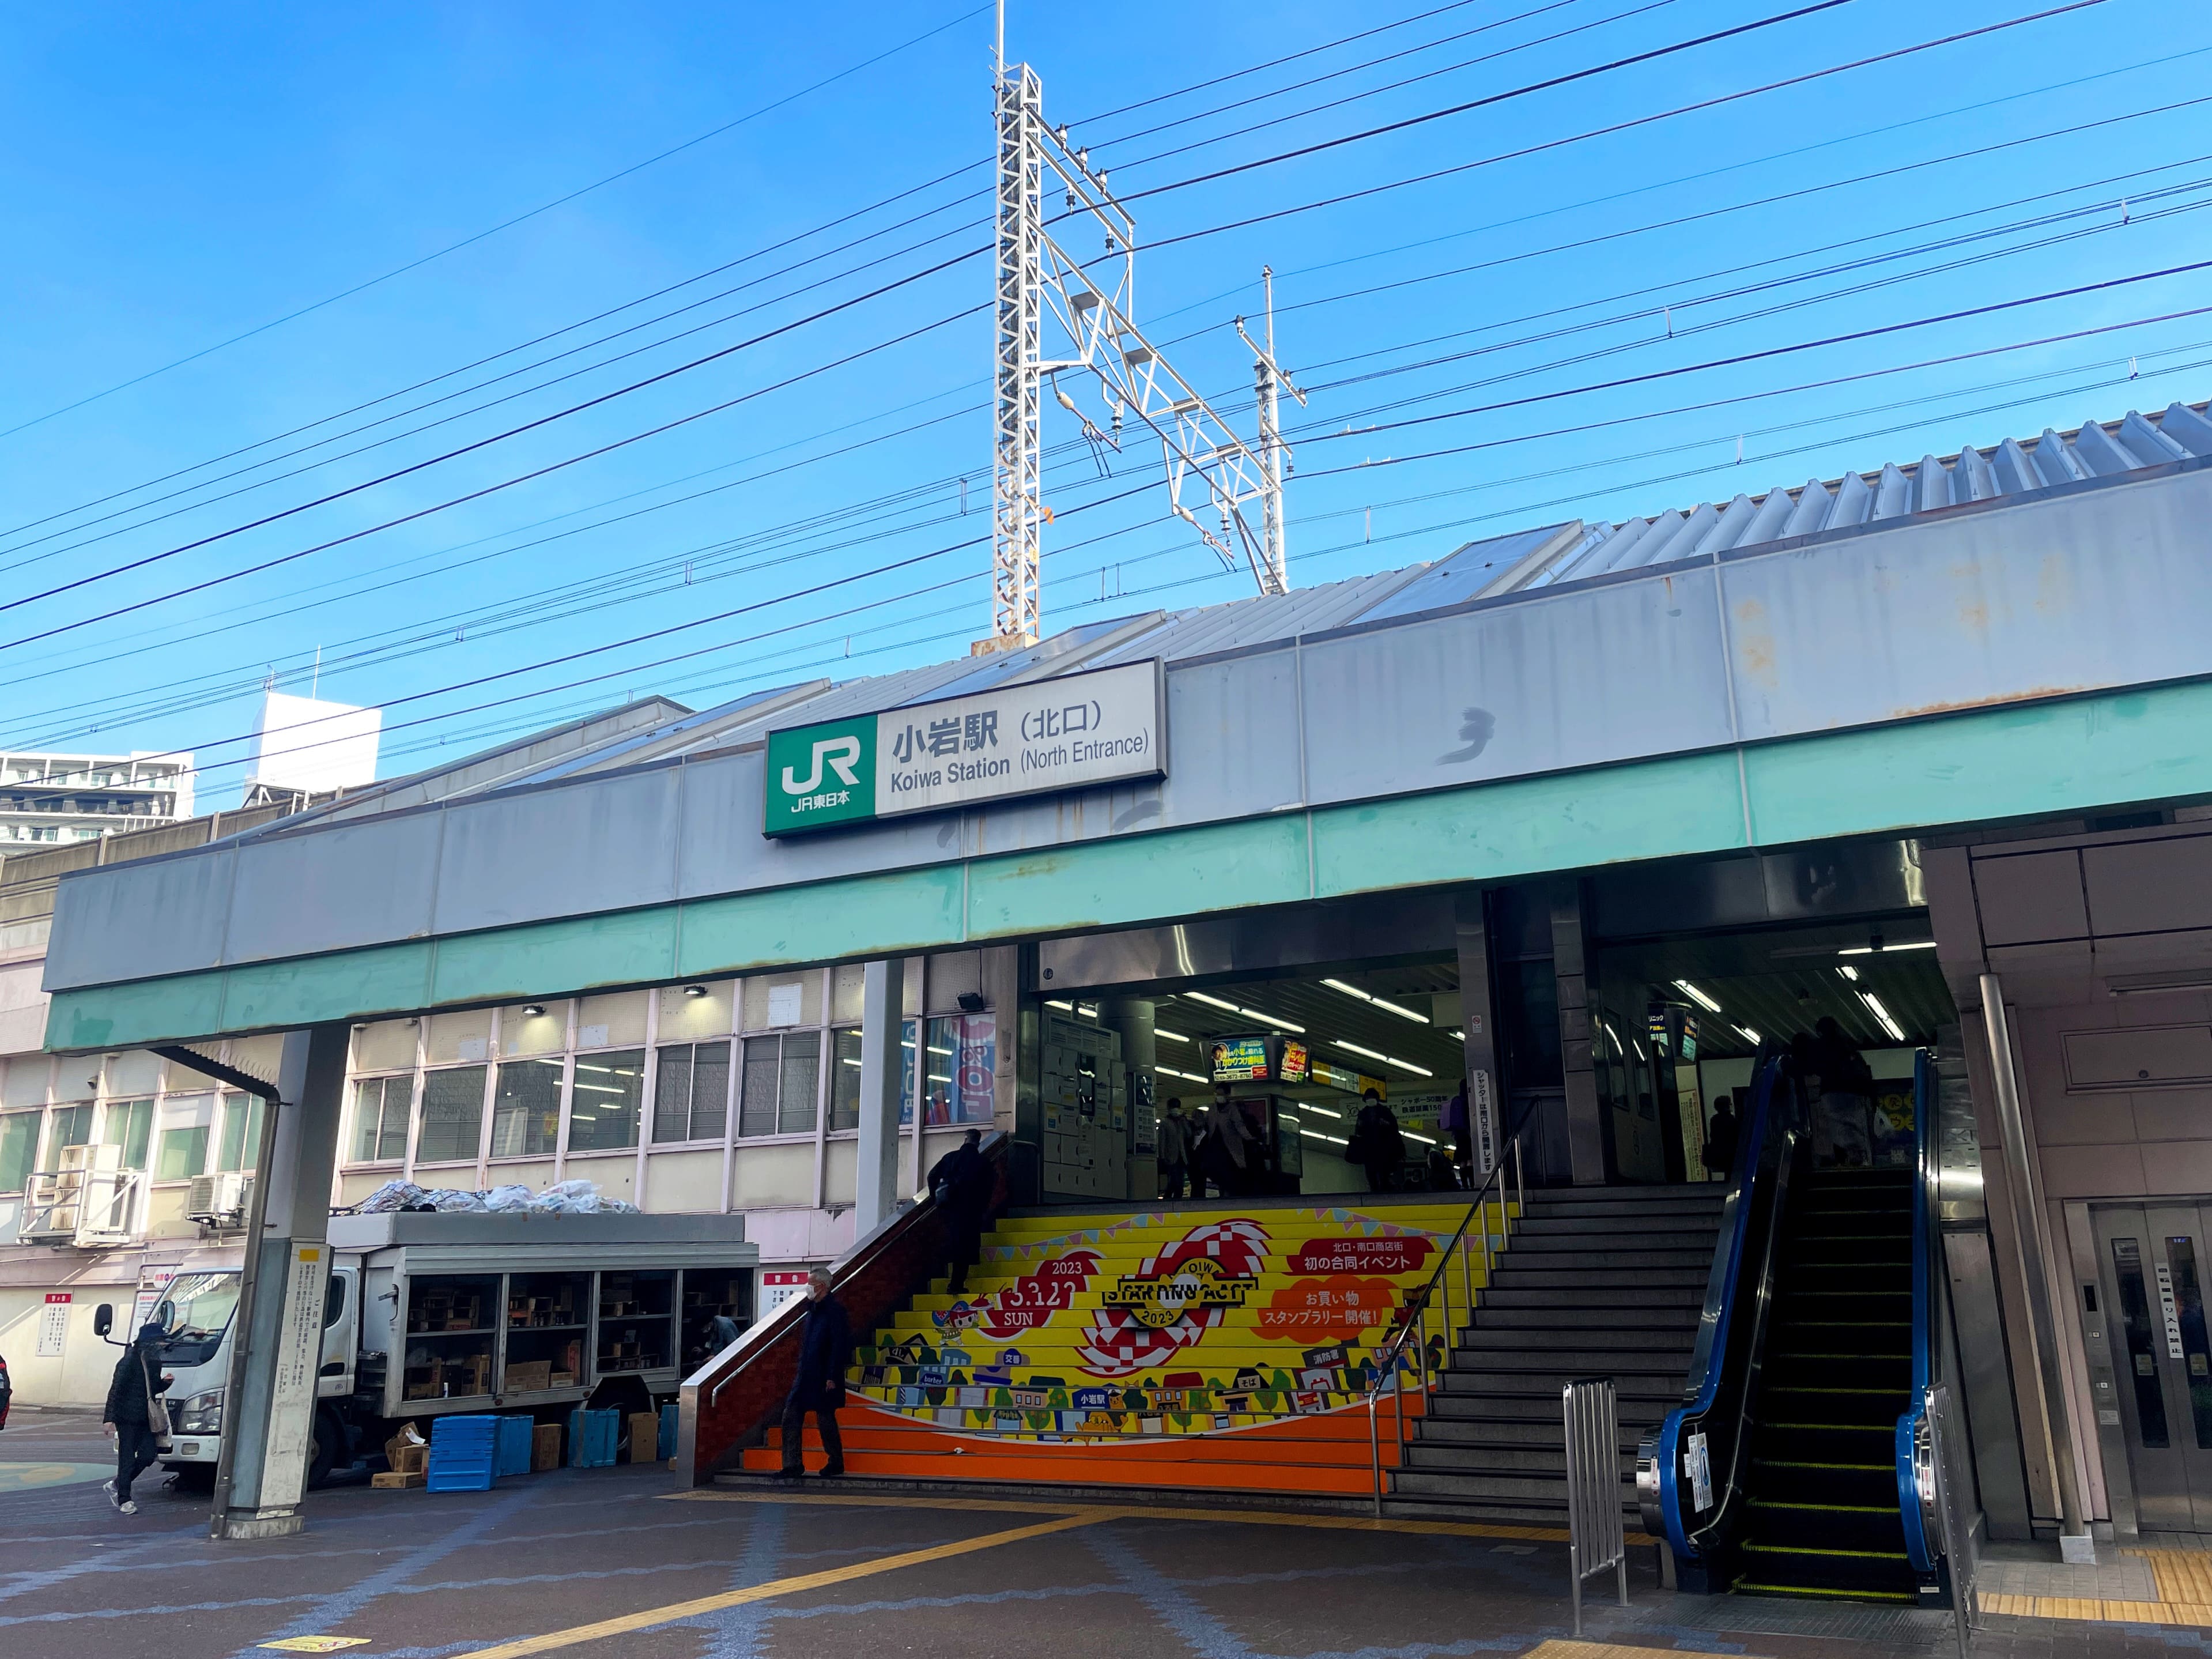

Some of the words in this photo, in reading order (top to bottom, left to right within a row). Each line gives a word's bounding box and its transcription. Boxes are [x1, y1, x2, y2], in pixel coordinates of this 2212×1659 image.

[892, 710, 998, 764] 小岩駅
[1021, 700, 1102, 742] （北口）
[782, 736, 860, 795] JR
[891, 768, 942, 793] Koiwa
[948, 756, 1010, 784] Station
[1021, 745, 1069, 774] (North
[1073, 728, 1149, 764] Entrance)
[791, 790, 851, 813] JR東日本
[1333, 1241, 1403, 1253] 北口・南口商店街
[1052, 1261, 1082, 1275] 2023
[1304, 1255, 1411, 1271] 初の合同イベント
[1010, 1281, 1076, 1306] 3.12
[1108, 1284, 1210, 1301] STARTING
[1203, 1283, 1254, 1299] ACT
[1306, 1291, 1360, 1306] お買い物
[1004, 1312, 1033, 1326] SUN
[1141, 1310, 1174, 1325] 2023
[1005, 1353, 1021, 1365] 交番
[1313, 1349, 1340, 1364] 消防署
[924, 1375, 942, 1384] barber
[1240, 1378, 1257, 1388] そば
[1080, 1394, 1106, 1405] 小岩駅
